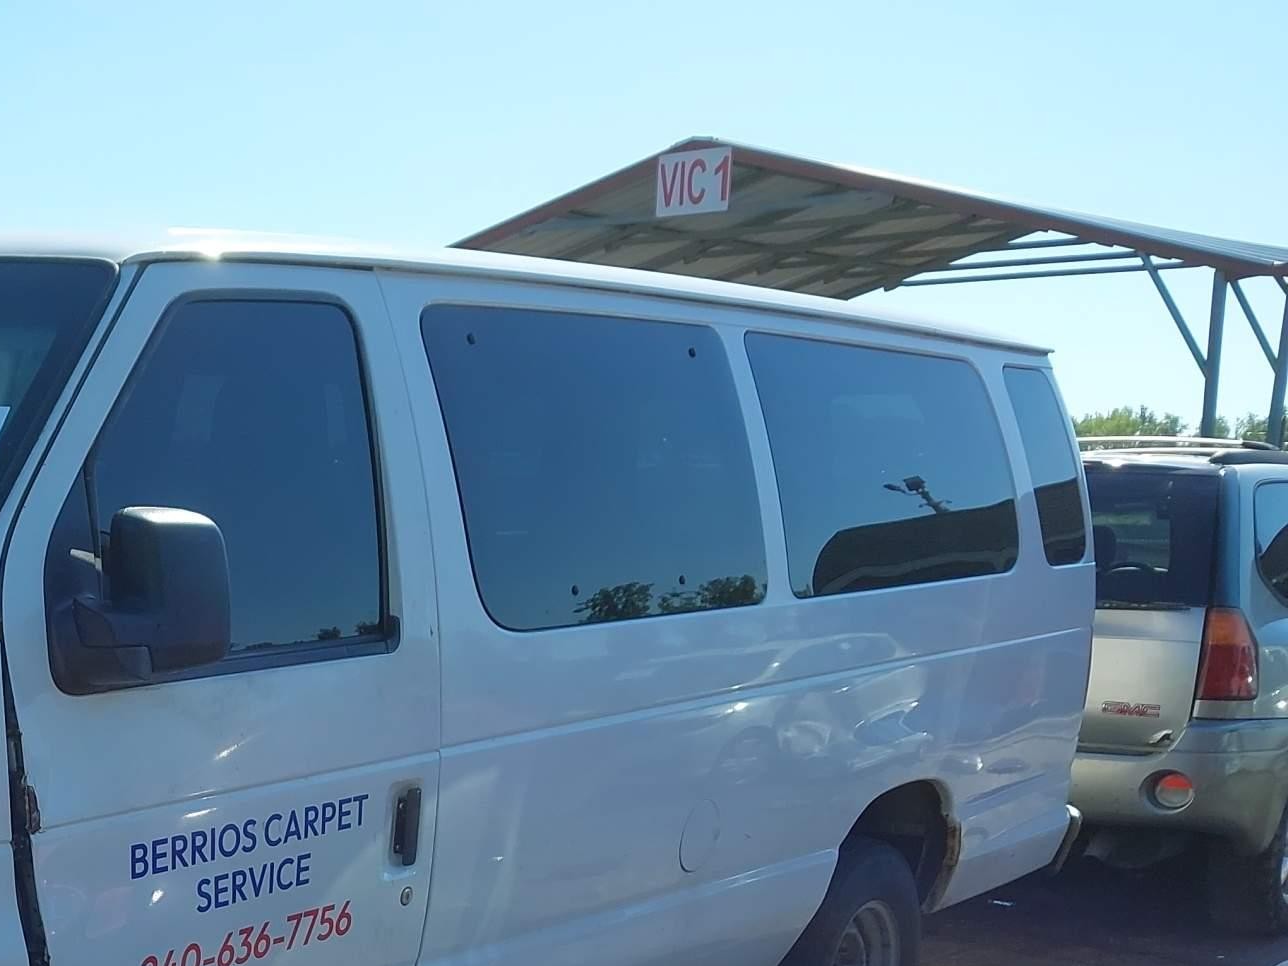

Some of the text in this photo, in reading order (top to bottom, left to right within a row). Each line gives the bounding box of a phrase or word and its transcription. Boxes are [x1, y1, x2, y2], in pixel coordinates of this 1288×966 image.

[660, 155, 730, 208] VIC 1
[1101, 700, 1161, 718] GMC
[130, 794, 369, 880] BERRIOS CARPET
[196, 853, 312, 913] SERVICE
